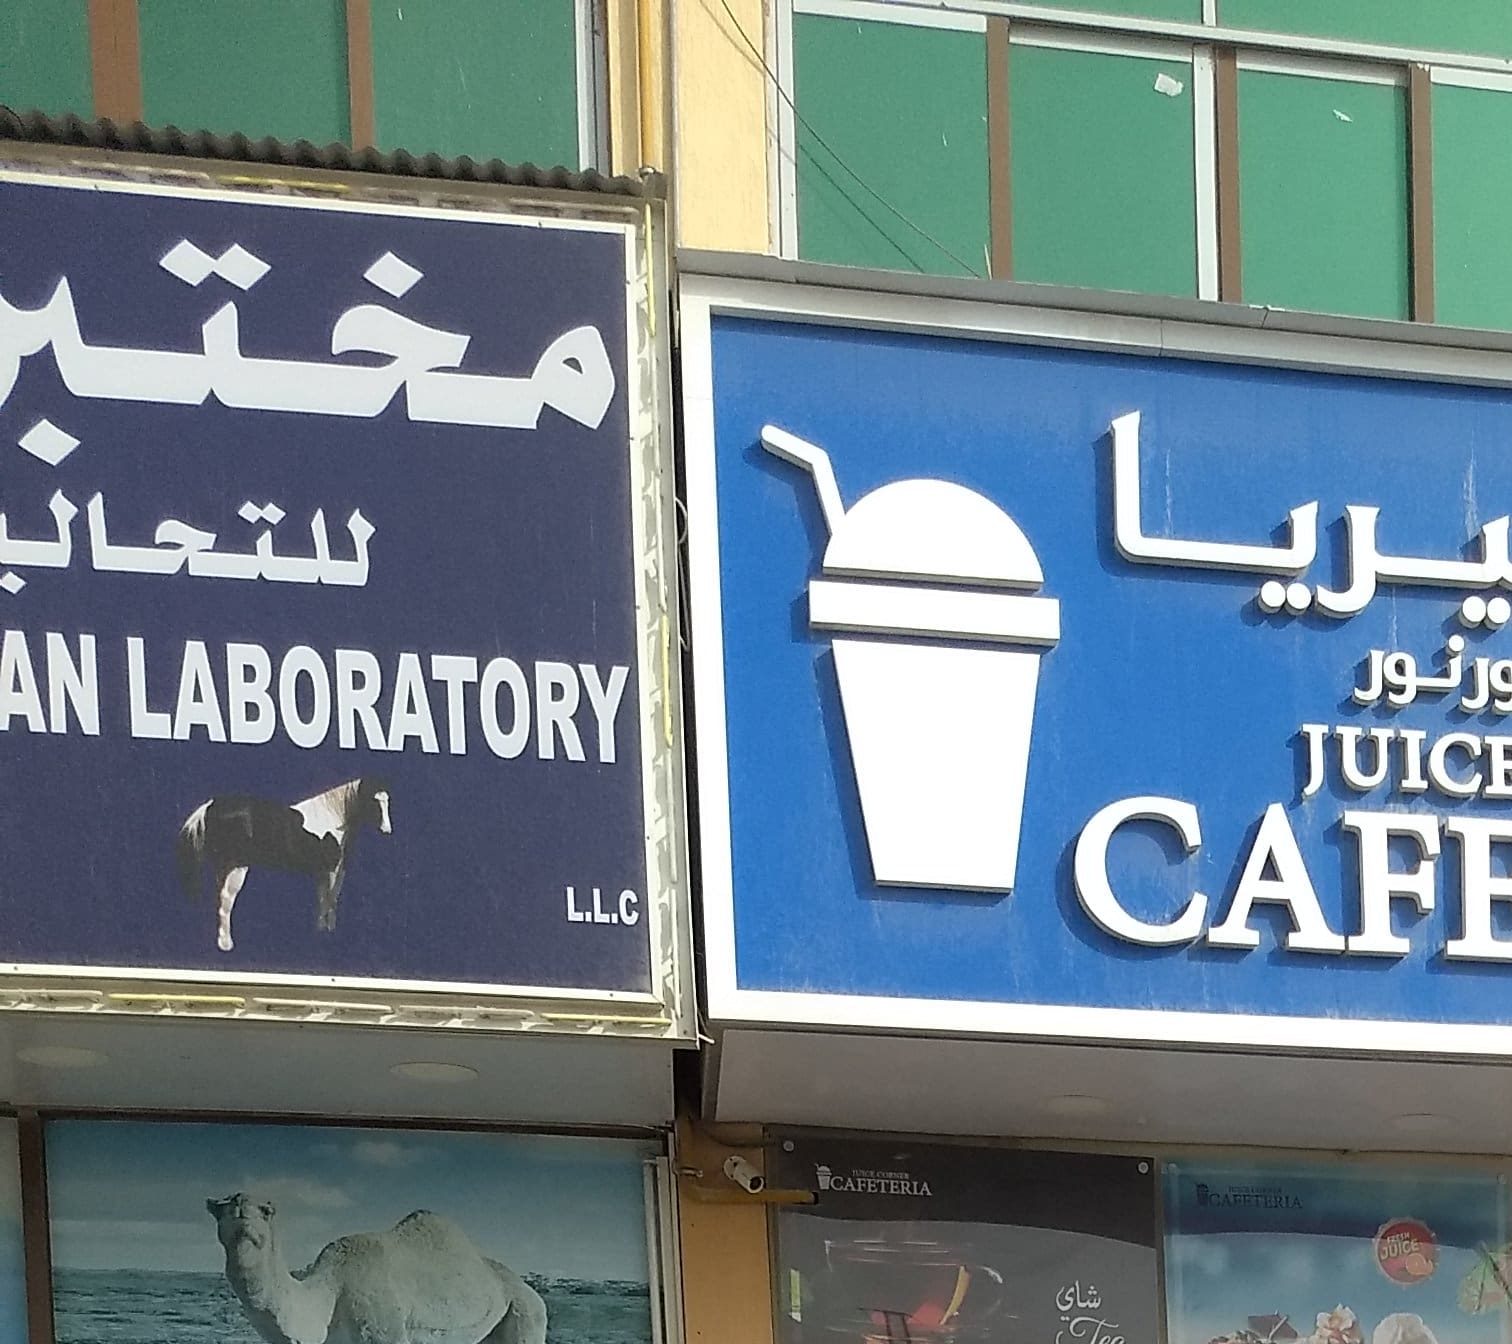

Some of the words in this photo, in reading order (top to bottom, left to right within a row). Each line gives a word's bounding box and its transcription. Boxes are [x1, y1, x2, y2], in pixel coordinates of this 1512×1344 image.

[127, 635, 630, 765] LABORATORY
[566, 886, 640, 926] L.L.C
[830, 1176, 933, 1196] CAFETERIA
[1380, 1238, 1420, 1260] JUICE
[1055, 1280, 1102, 1322] شاي
